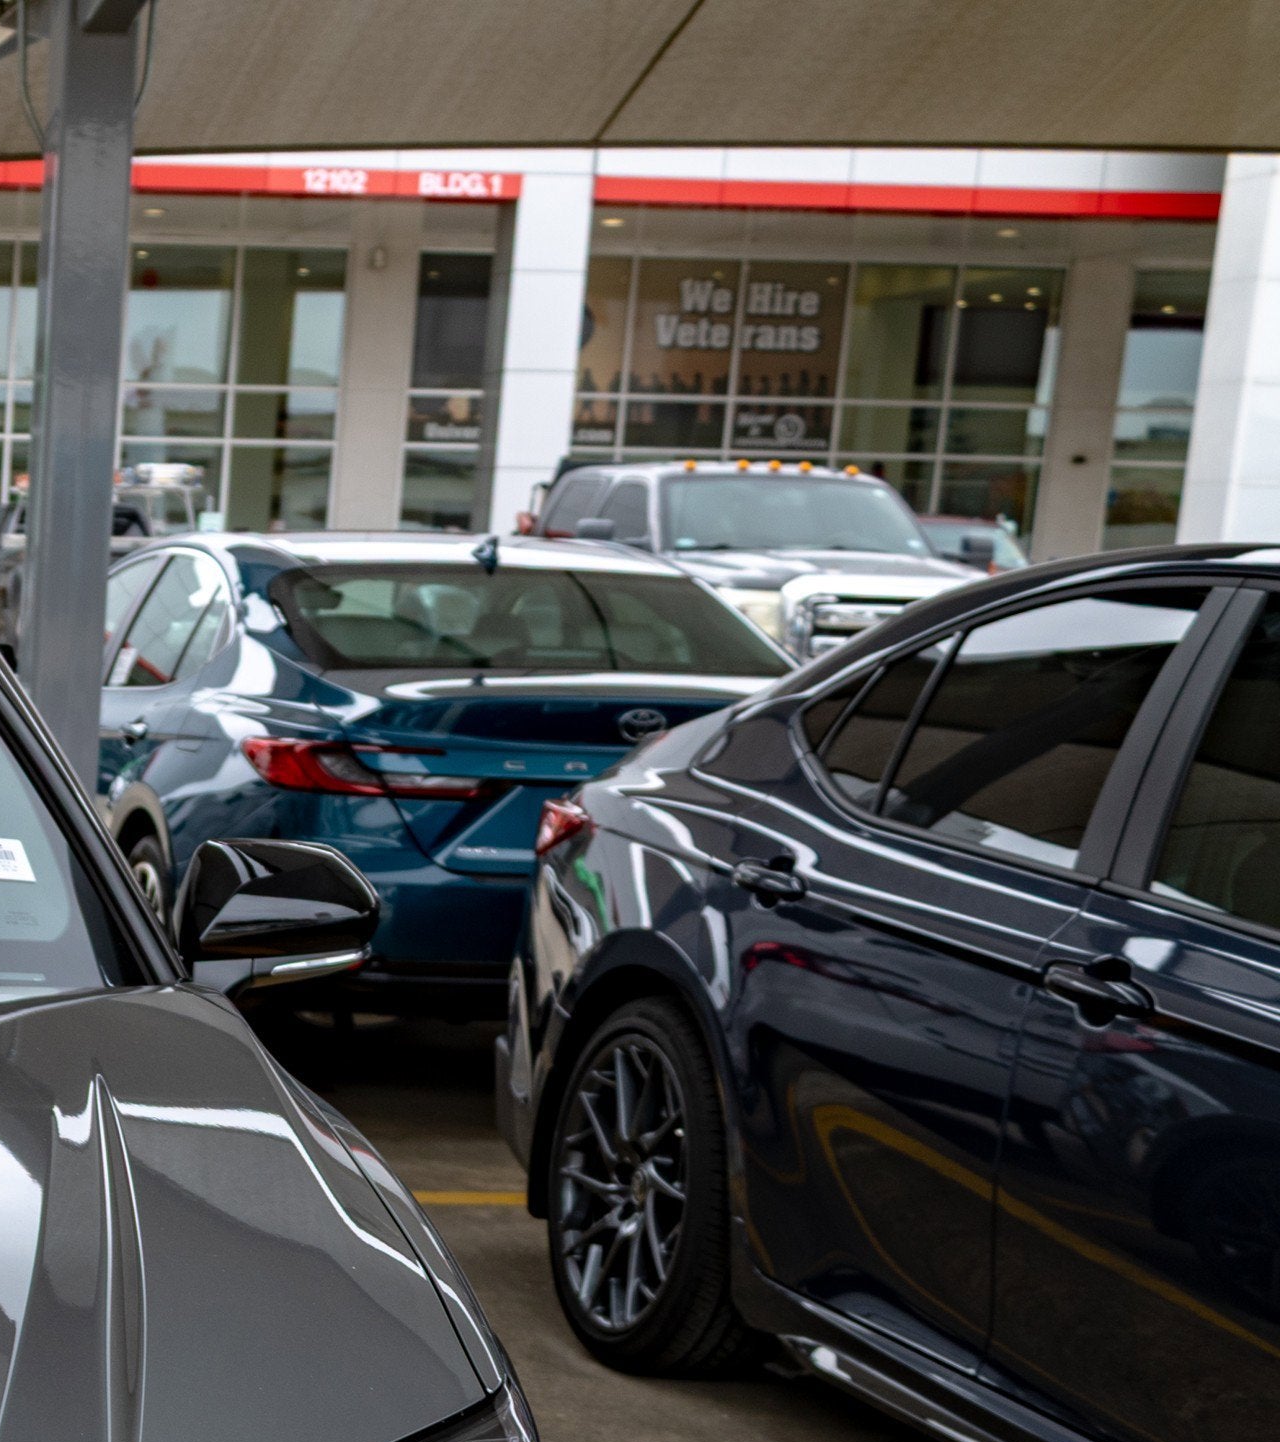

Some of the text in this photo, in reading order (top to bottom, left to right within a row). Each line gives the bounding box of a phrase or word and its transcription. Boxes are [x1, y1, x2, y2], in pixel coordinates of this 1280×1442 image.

[304, 170, 367, 194] 12102
[490, 174, 503, 195] 1
[680, 278, 821, 316] We Hire
[655, 314, 821, 350] Veterans
